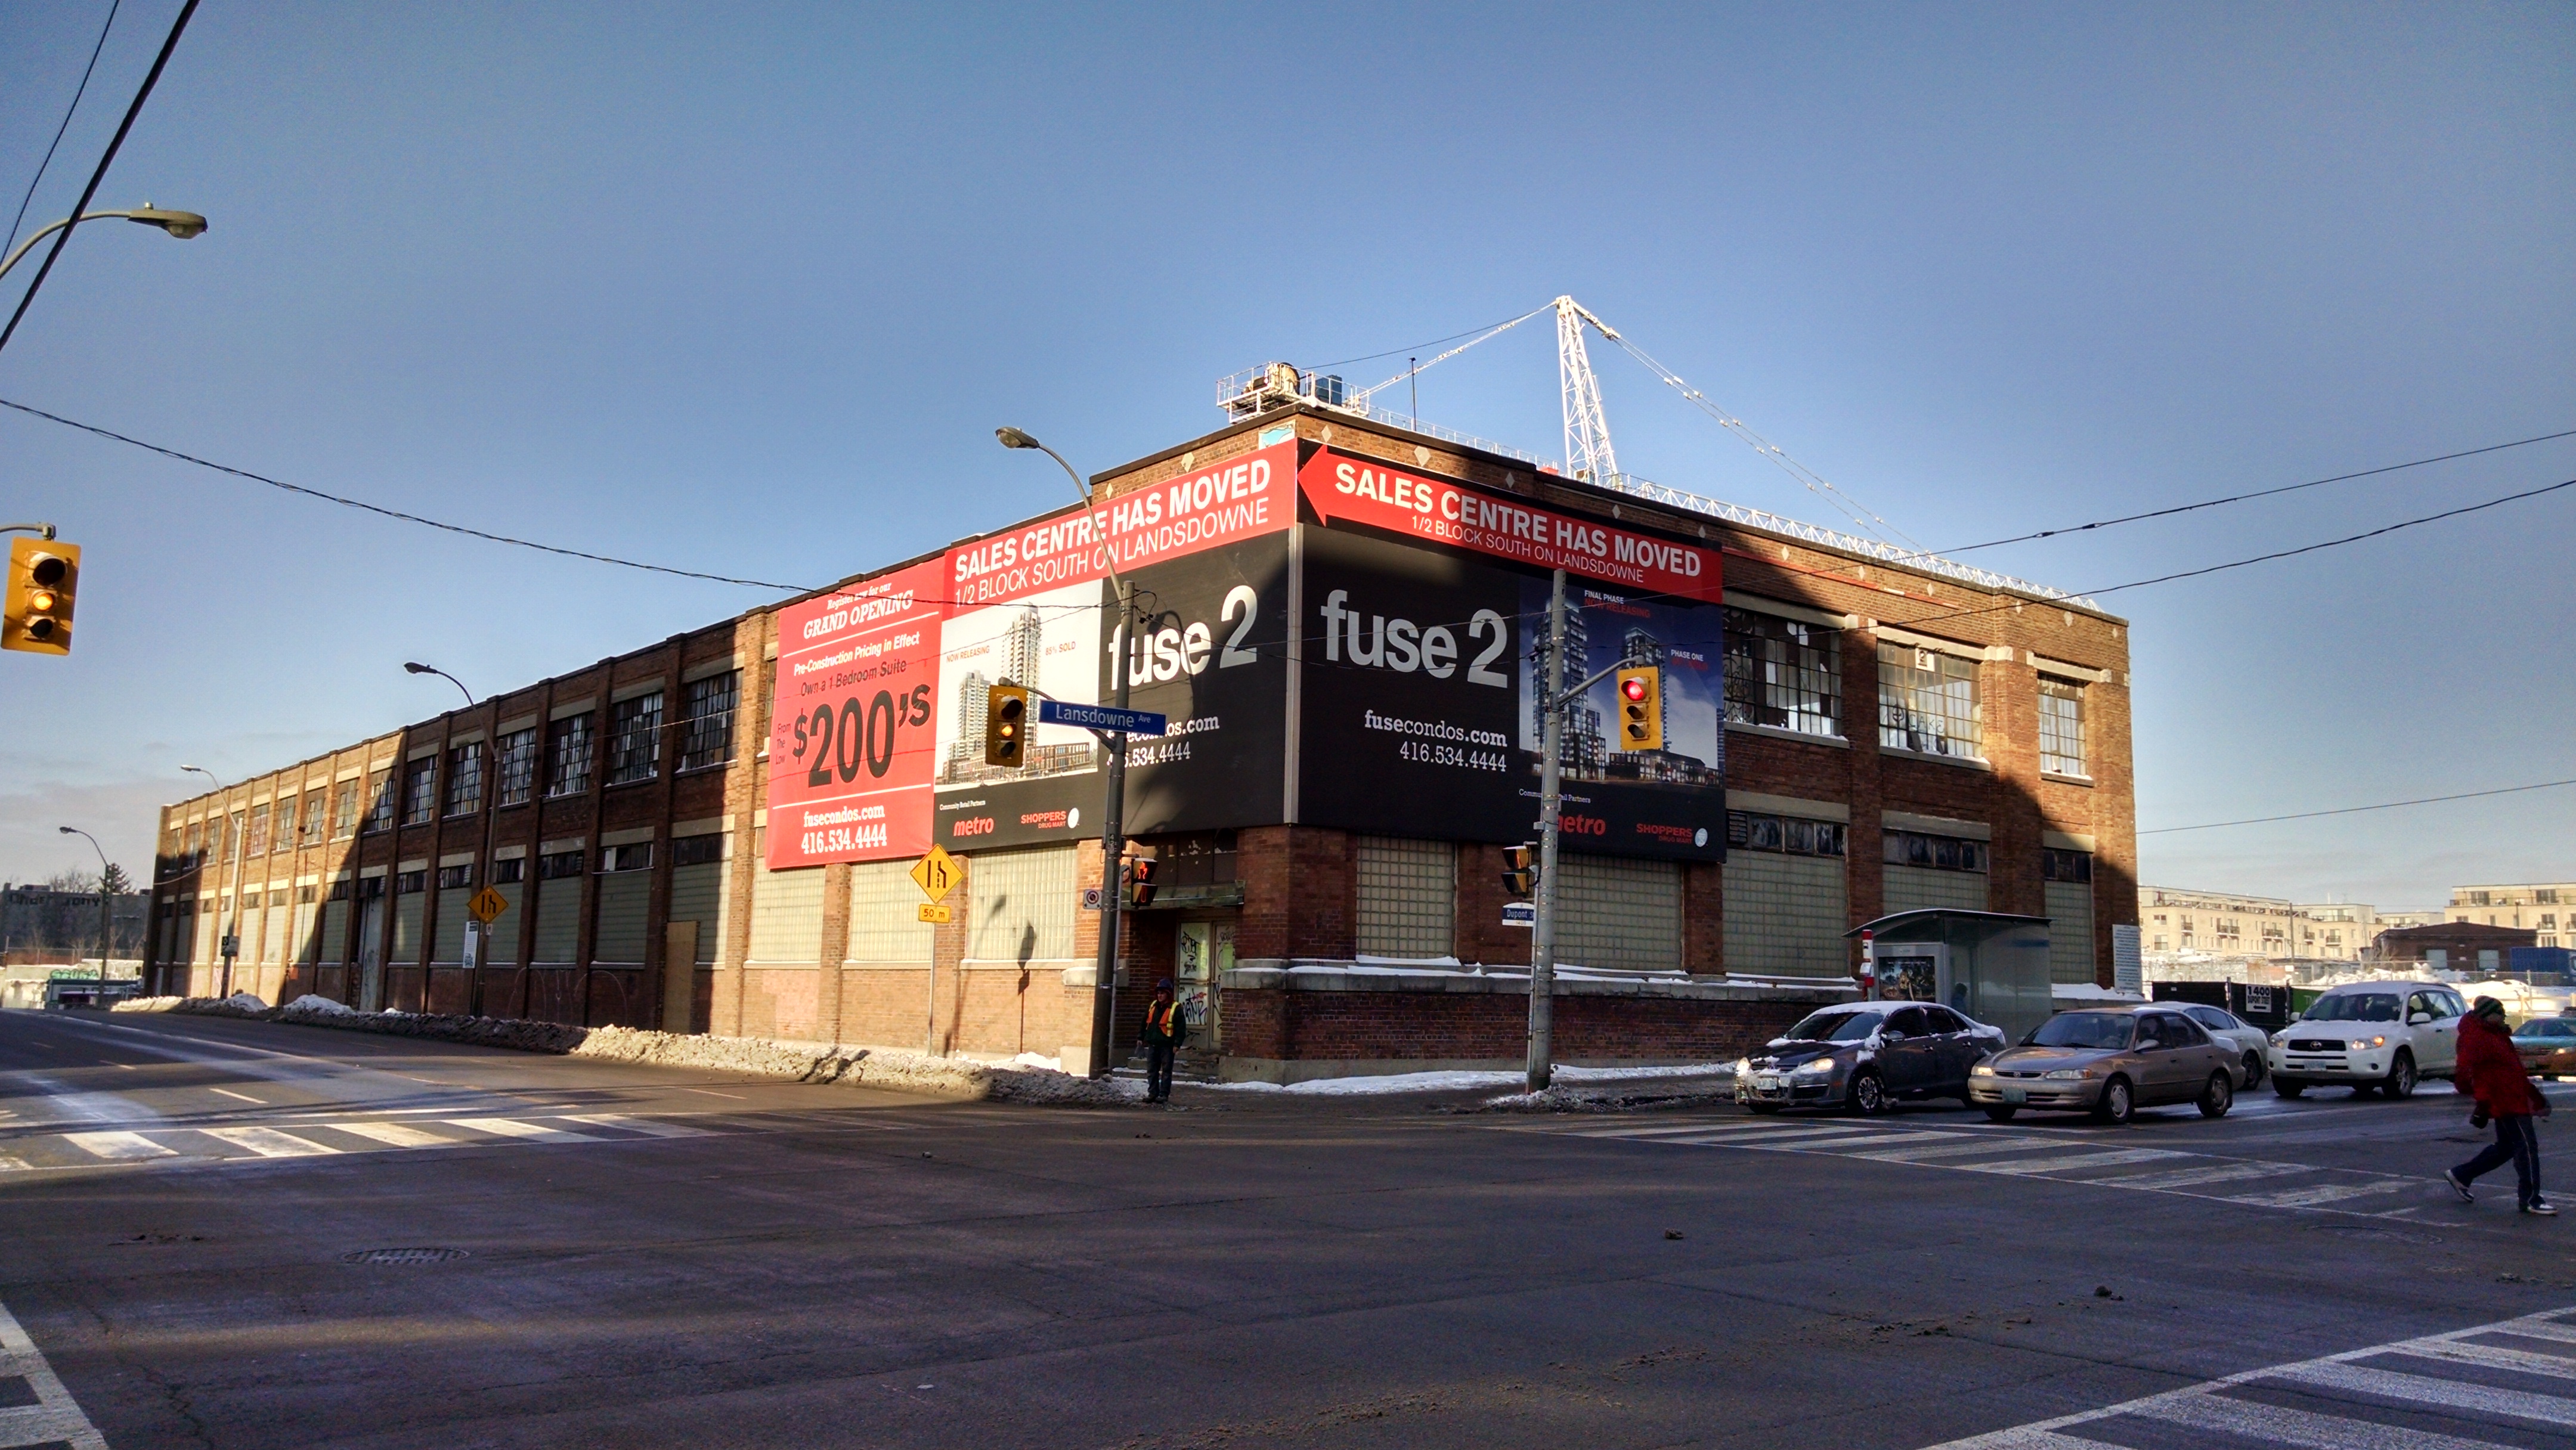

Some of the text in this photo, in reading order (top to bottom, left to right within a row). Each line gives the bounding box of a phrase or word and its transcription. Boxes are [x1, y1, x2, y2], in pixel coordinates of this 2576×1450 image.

[955, 458, 1271, 583] SALES CENTRE HAS MOVED
[1335, 462, 1701, 578] SALES CENTRE HAS MOVED
[955, 497, 1270, 609] 1/2 BLOCK SOUTH ON LANDSDOWNE
[1411, 516, 1644, 584] 1/2 BLOCK SOUTH ON LANDSDOWNE
[827, 596, 853, 610] Register
[869, 585, 878, 596] for
[880, 583, 891, 593] our
[1584, 590, 1624, 604] FINAL PHASE
[803, 590, 914, 639] GRAND OPENING
[1584, 598, 1651, 618] NOW RELEASING
[1059, 641, 1076, 653] SOLD
[1109, 585, 1258, 690] fuse 2
[1320, 590, 1508, 689] fuse 2
[794, 631, 920, 676] Pre-Construction Pricing in Effect
[946, 645, 990, 663] NOW RELEASING
[1671, 649, 1704, 662] PHASE ONE
[801, 659, 906, 697] Own a 1 Bedroom Suite
[1056, 704, 1151, 727] Lansdowne Ave
[778, 723, 791, 735] From
[1364, 709, 1508, 748] fusecondos.com
[777, 738, 785, 749] The
[776, 754, 785, 765] Low
[1400, 741, 1507, 773] 416.534.4444
[1568, 794, 1591, 804] Partners
[803, 805, 886, 828] fusecondos.com
[953, 816, 994, 836] metro
[1021, 811, 1066, 824] SHOPPERS
[801, 823, 887, 854] 416.534.4444
[1636, 823, 1693, 838] SHOPPERS
[924, 909, 934, 918] 50
[1507, 909, 1528, 919] Dupont
[2247, 986, 2270, 996] 1400
